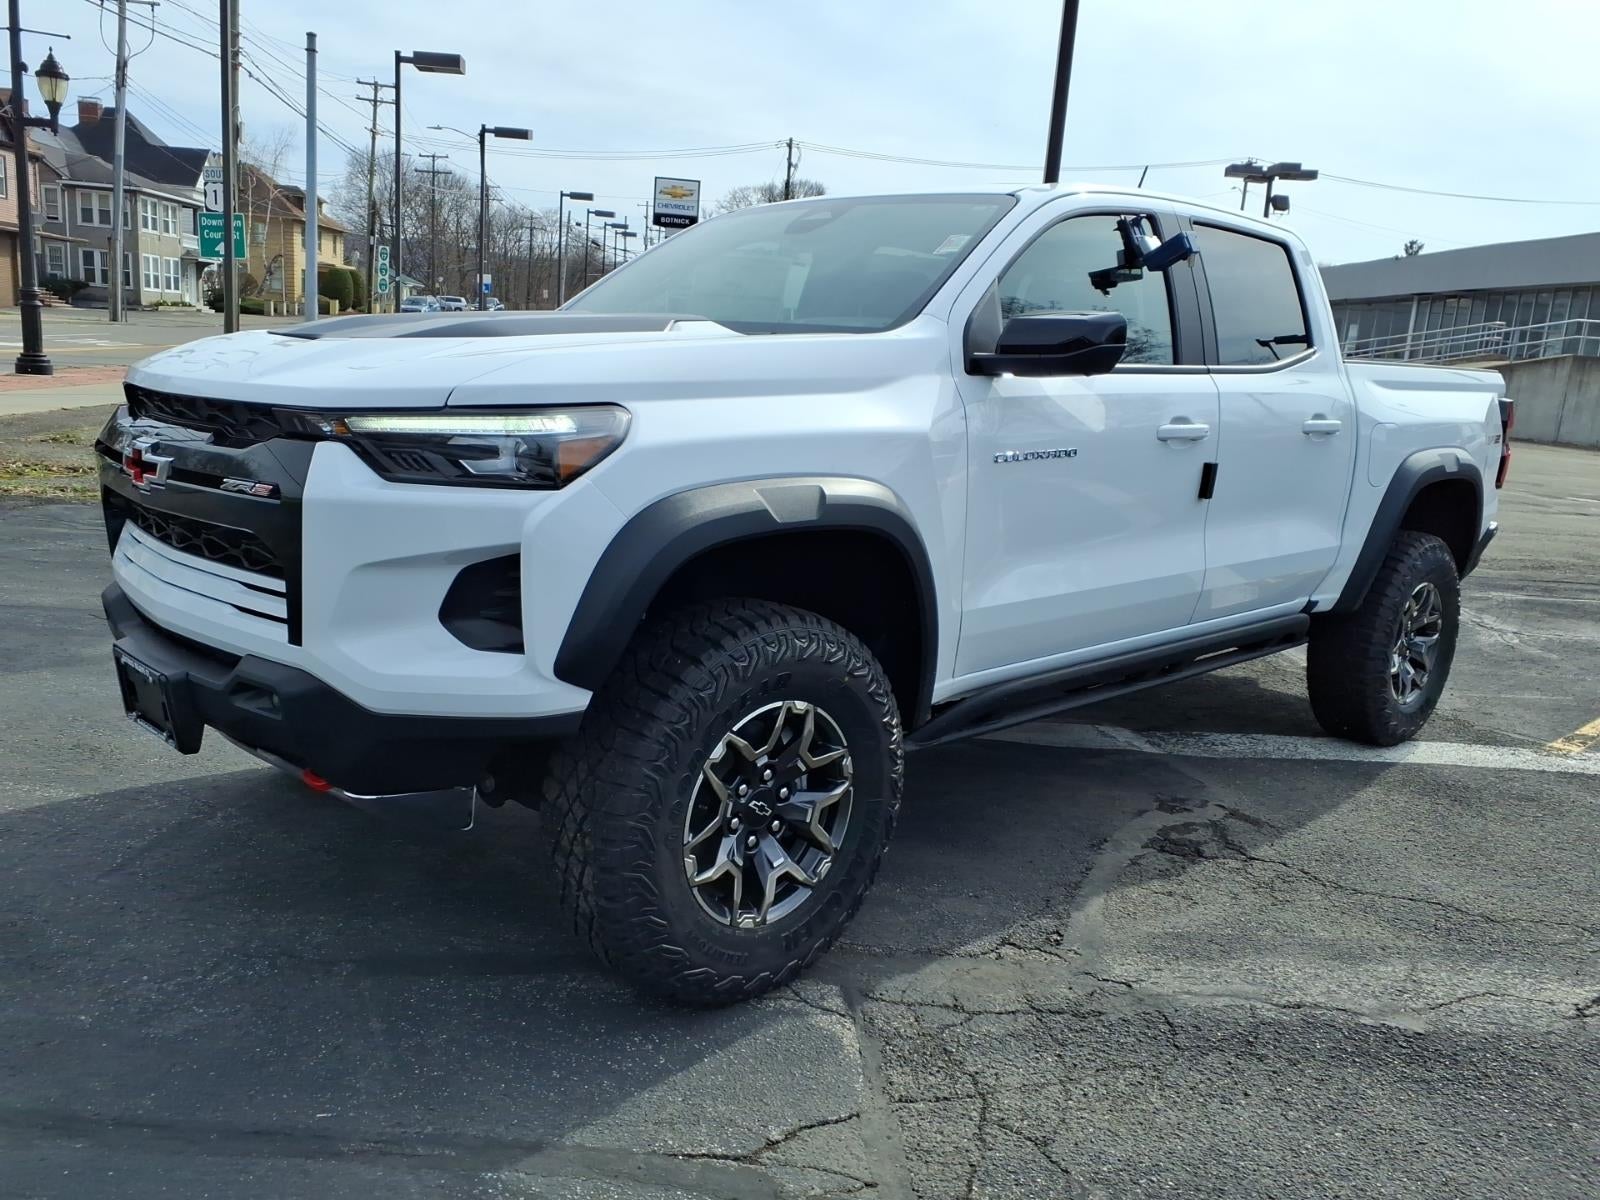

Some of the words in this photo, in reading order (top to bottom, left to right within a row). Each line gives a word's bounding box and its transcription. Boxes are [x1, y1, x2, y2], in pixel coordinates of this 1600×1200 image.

[204, 169, 222, 179] SOU
[657, 202, 696, 212] CHEVROLET
[201, 216, 242, 228] Downwn
[660, 216, 691, 225] BOTNICK
[993, 447, 1078, 464] COLORADO
[220, 478, 273, 497] ZR2
